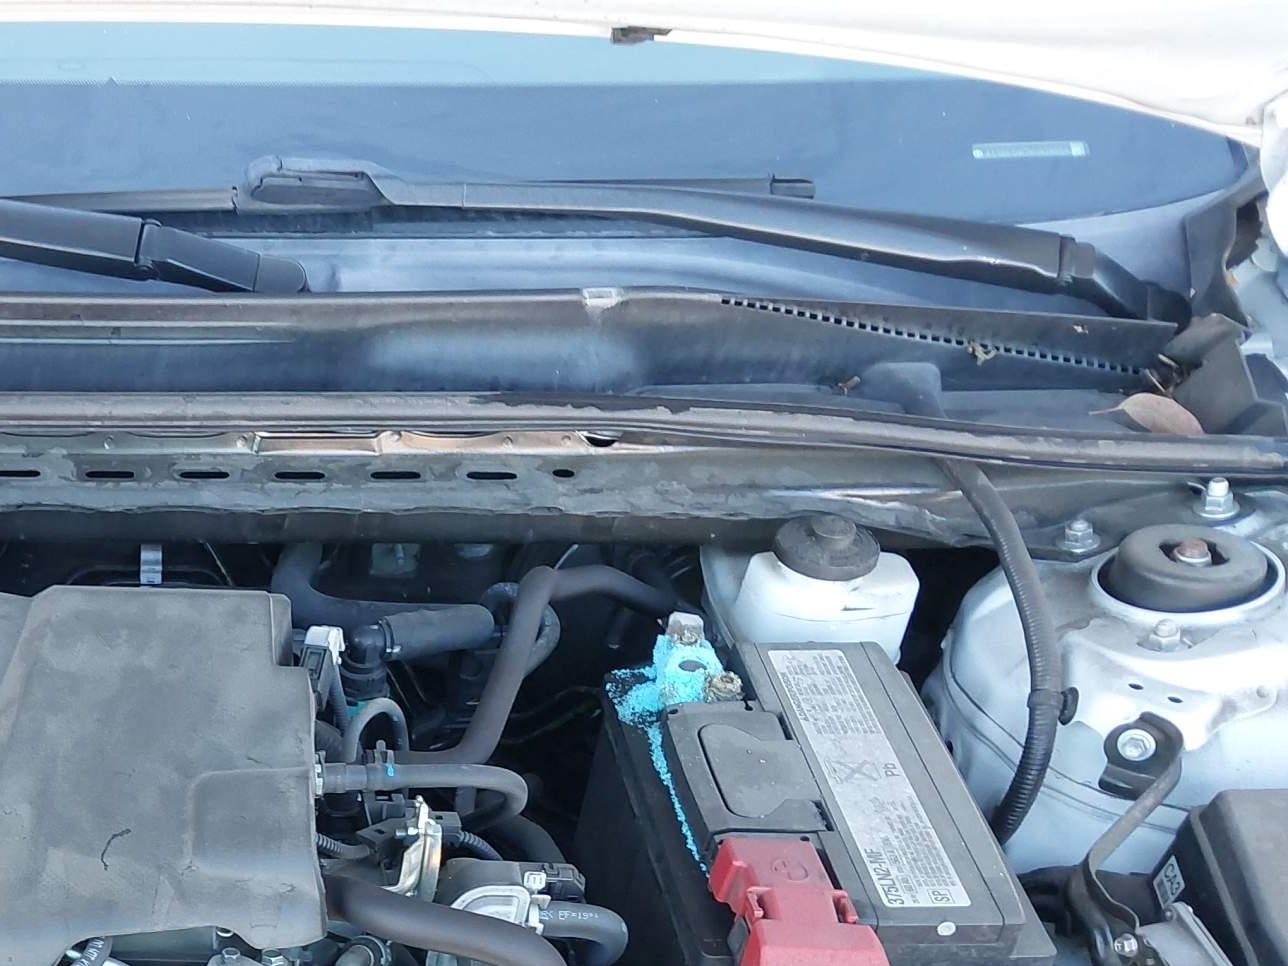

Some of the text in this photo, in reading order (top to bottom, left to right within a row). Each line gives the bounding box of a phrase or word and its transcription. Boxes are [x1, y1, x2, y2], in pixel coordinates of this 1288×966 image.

[882, 762, 900, 776] Pb
[864, 848, 905, 905] 375LN2-MF
[931, 890, 950, 902] SP
